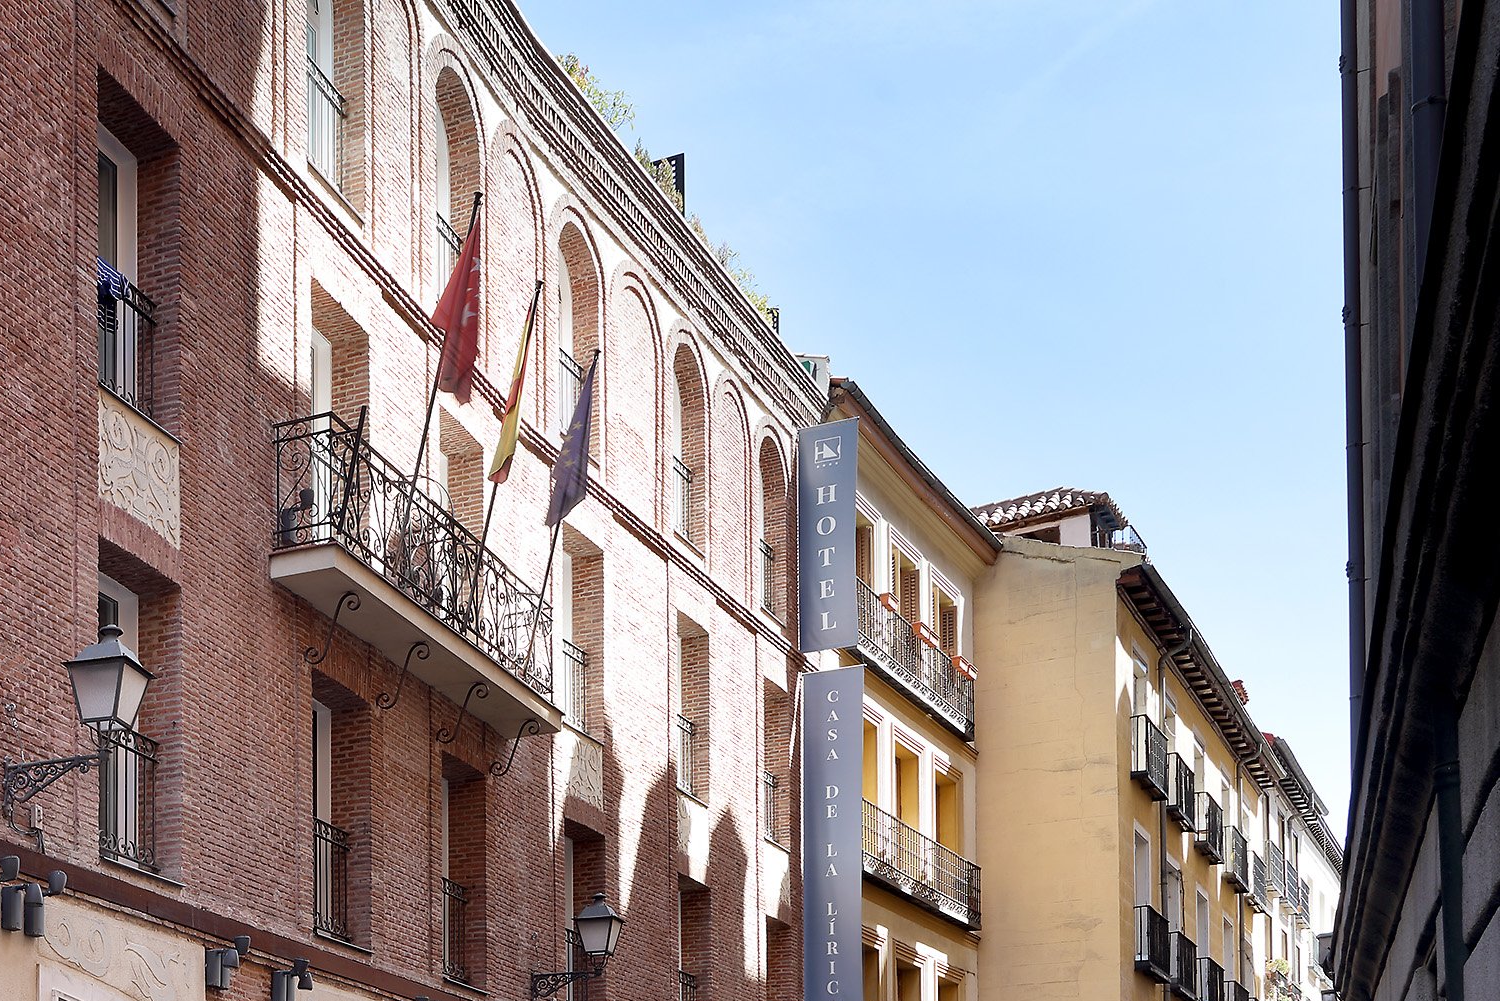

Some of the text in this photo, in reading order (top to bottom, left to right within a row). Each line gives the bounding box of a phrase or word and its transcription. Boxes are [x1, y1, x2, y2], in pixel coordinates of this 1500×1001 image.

[816, 483, 838, 631] HOTEL
[826, 690, 840, 761] CASA
[825, 785, 839, 819] DE
[825, 843, 839, 877] LA
